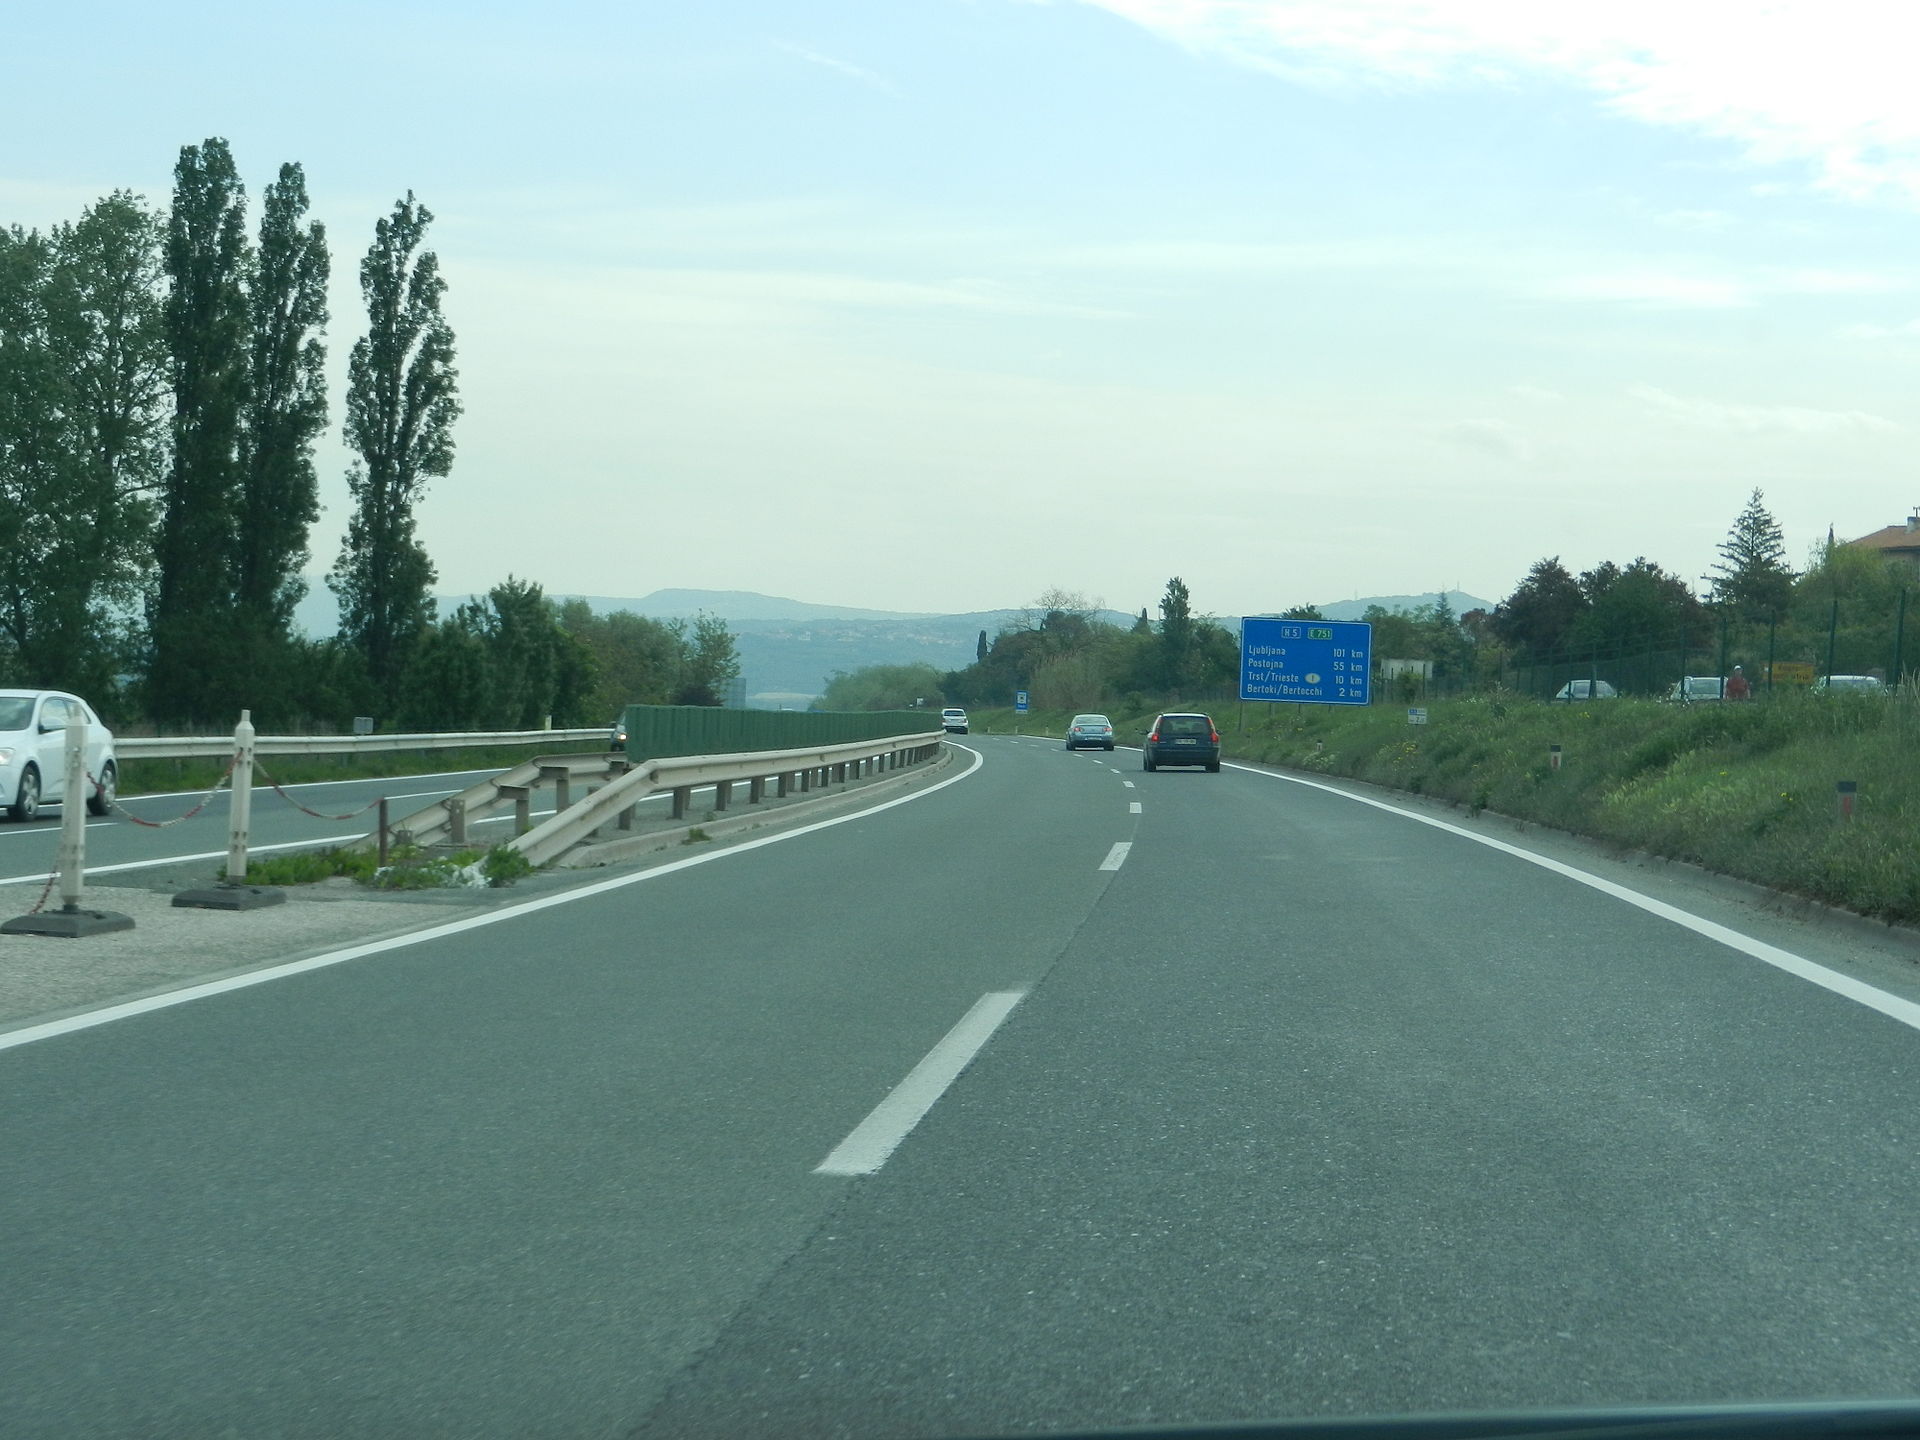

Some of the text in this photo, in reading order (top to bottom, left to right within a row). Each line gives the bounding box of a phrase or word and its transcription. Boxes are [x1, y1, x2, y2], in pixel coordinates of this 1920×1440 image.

[1317, 629, 1330, 638] 751
[1248, 644, 1363, 658] Ljubljana 101 km
[1248, 658, 1363, 671] Postojna 55 km
[1248, 671, 1299, 682] Trst/Trieste
[1335, 675, 1344, 684] 10
[1350, 676, 1362, 685] km
[1247, 683, 1362, 697] Bertoki/Bertocchi 2 km
